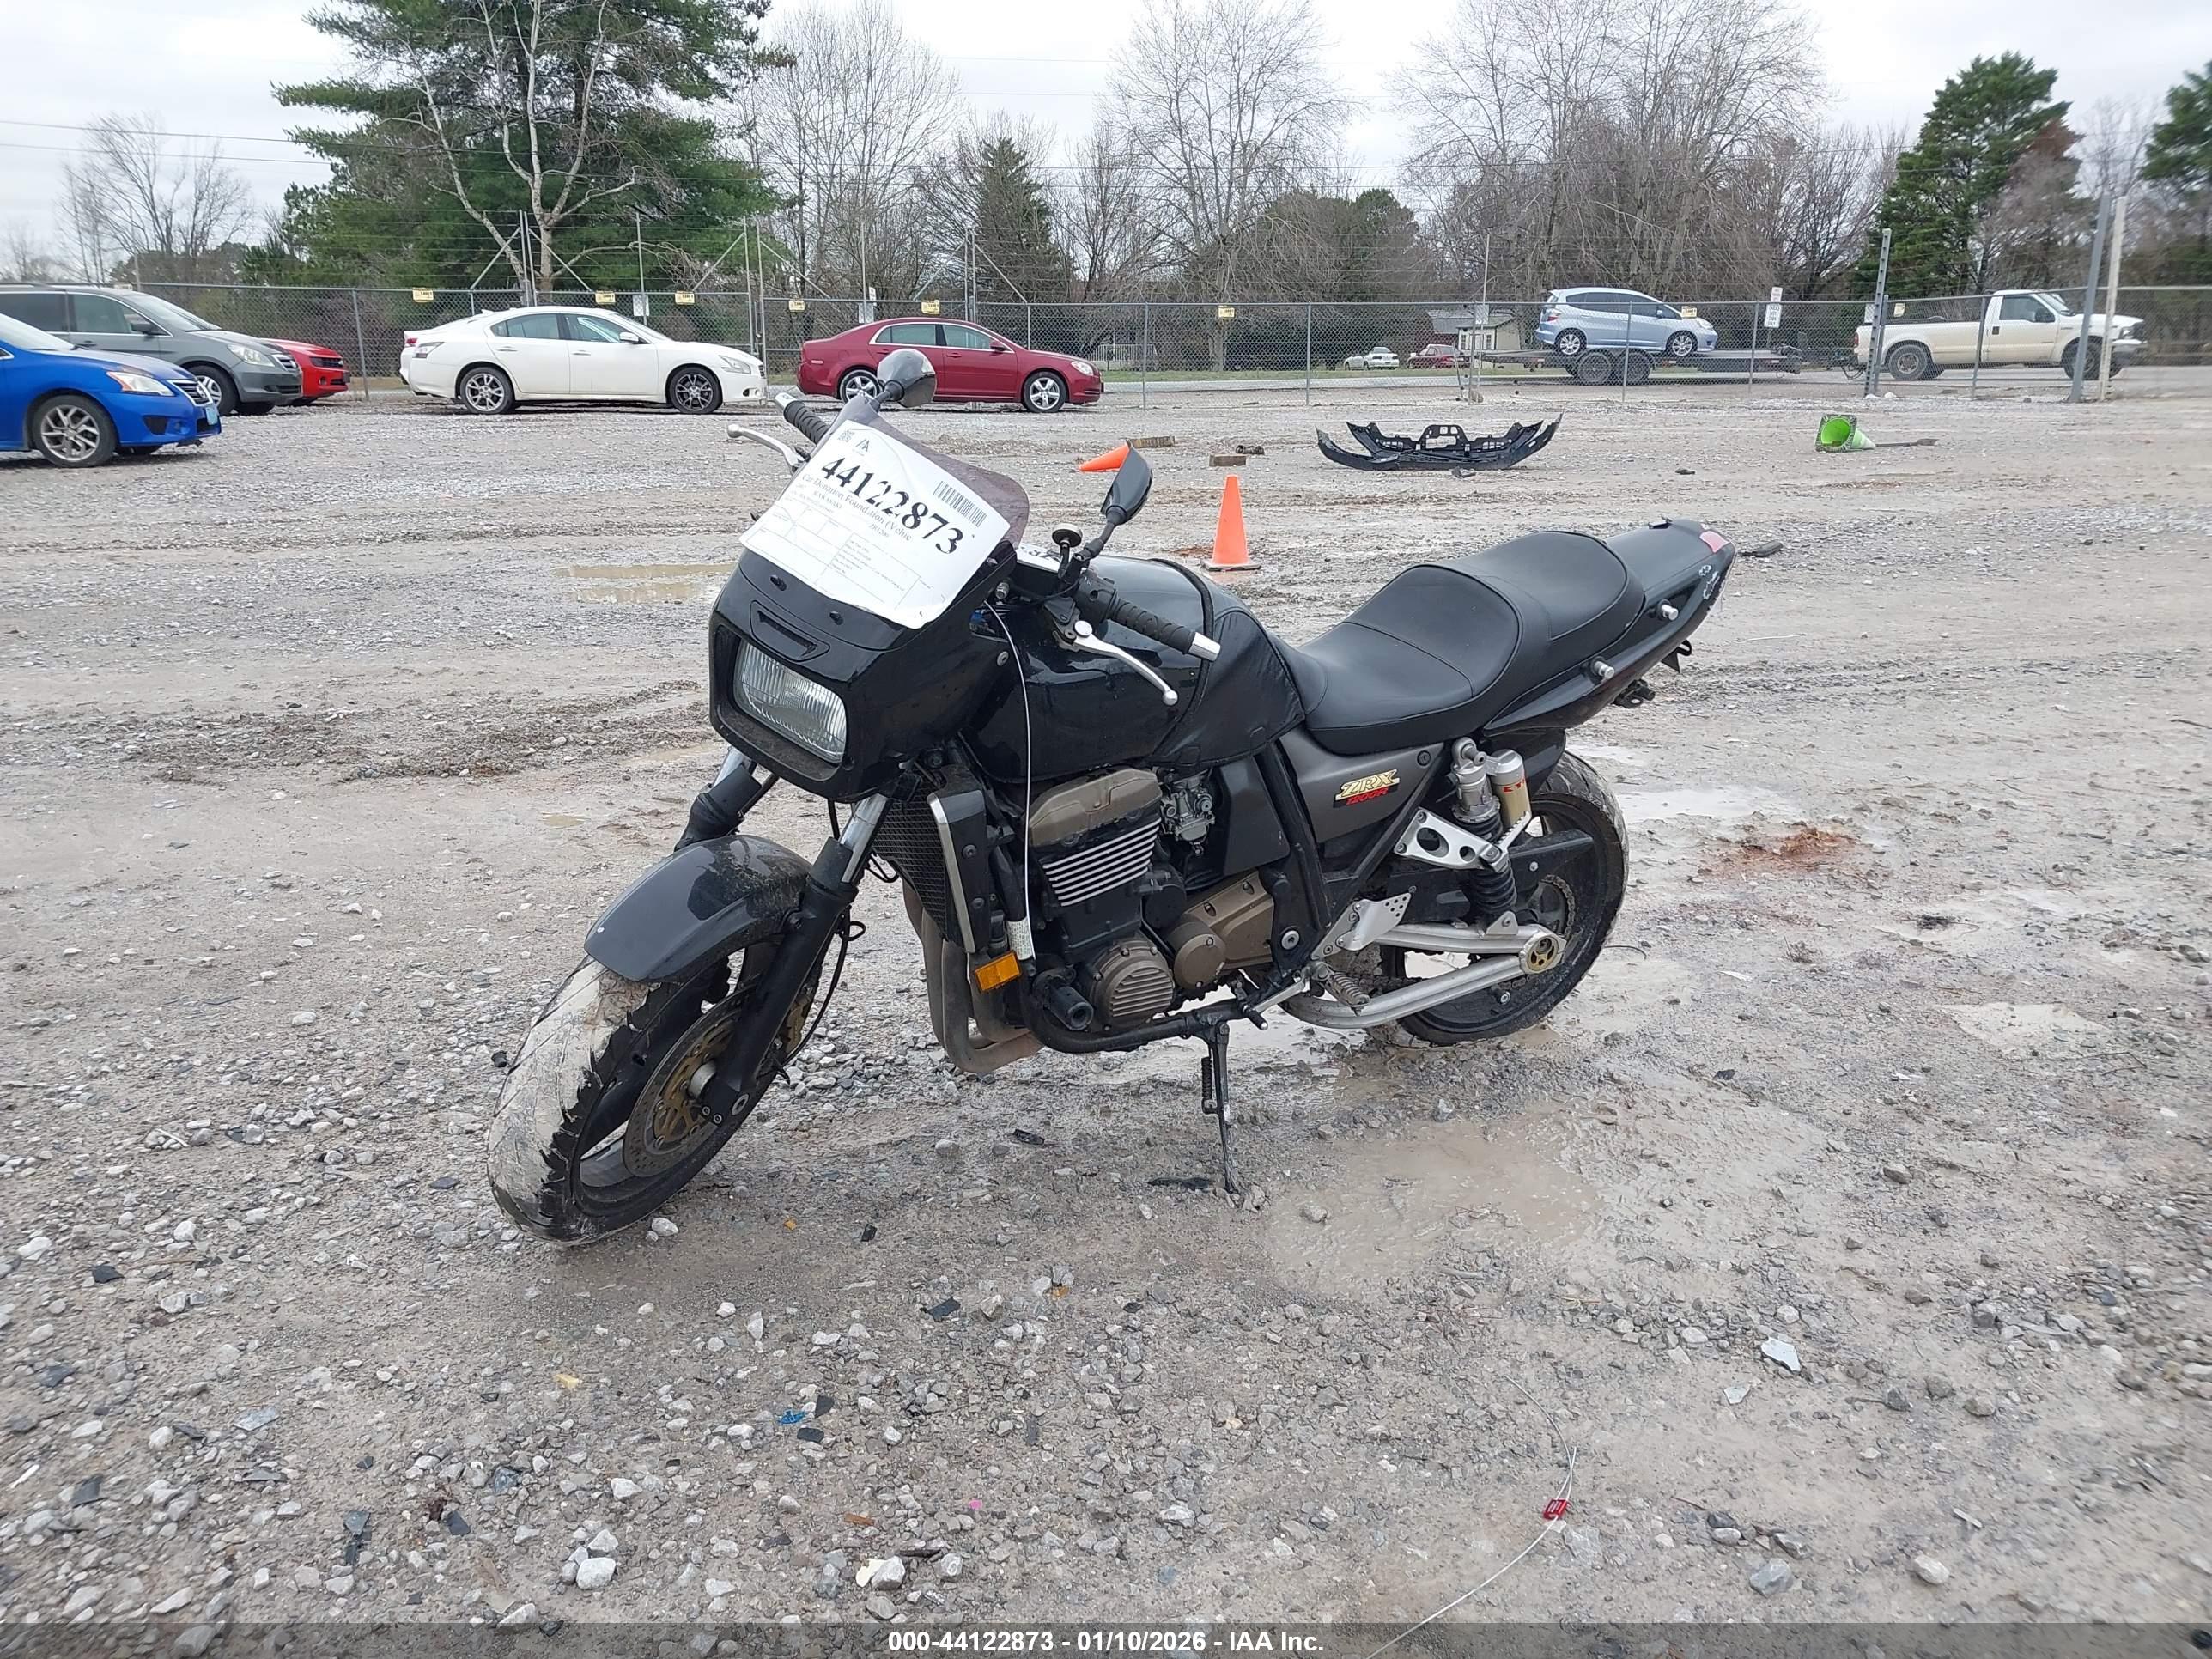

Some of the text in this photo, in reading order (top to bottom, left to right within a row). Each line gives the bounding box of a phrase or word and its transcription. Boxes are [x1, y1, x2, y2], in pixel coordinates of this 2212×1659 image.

[813, 478, 845, 501] Donation
[821, 457, 963, 555] 44122873
[1340, 769, 1398, 799] ZRX
